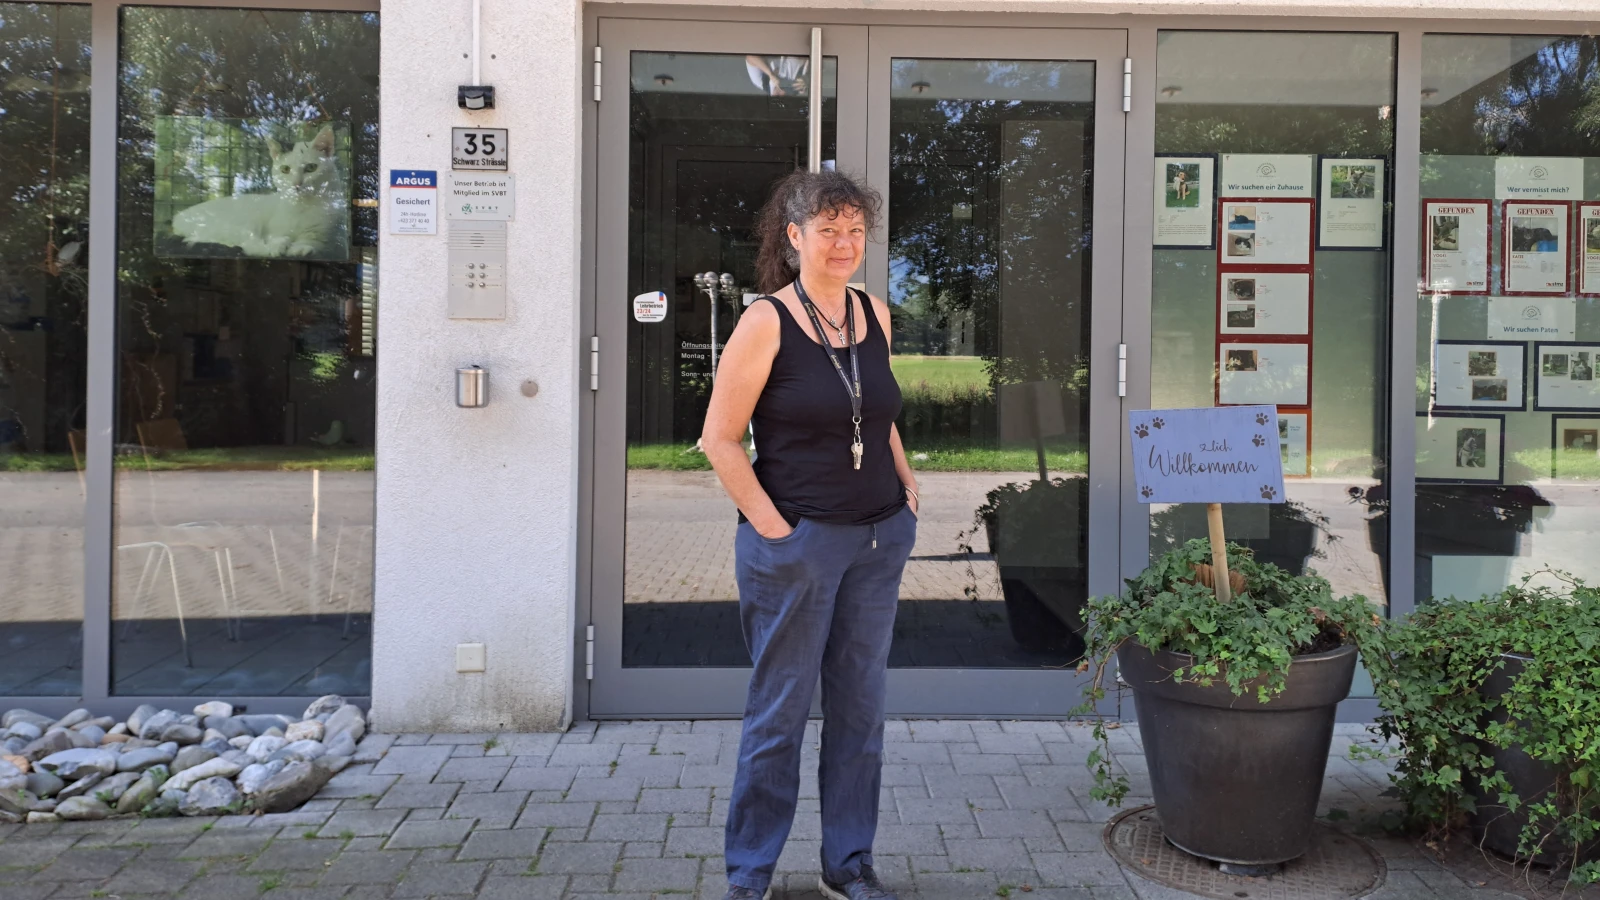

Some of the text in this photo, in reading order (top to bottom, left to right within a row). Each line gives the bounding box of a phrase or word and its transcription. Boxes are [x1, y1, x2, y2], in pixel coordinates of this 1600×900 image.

[464, 134, 496, 156] 35
[453, 158, 506, 166] Schwarz Strässle
[1148, 444, 1260, 477] Willkommen
